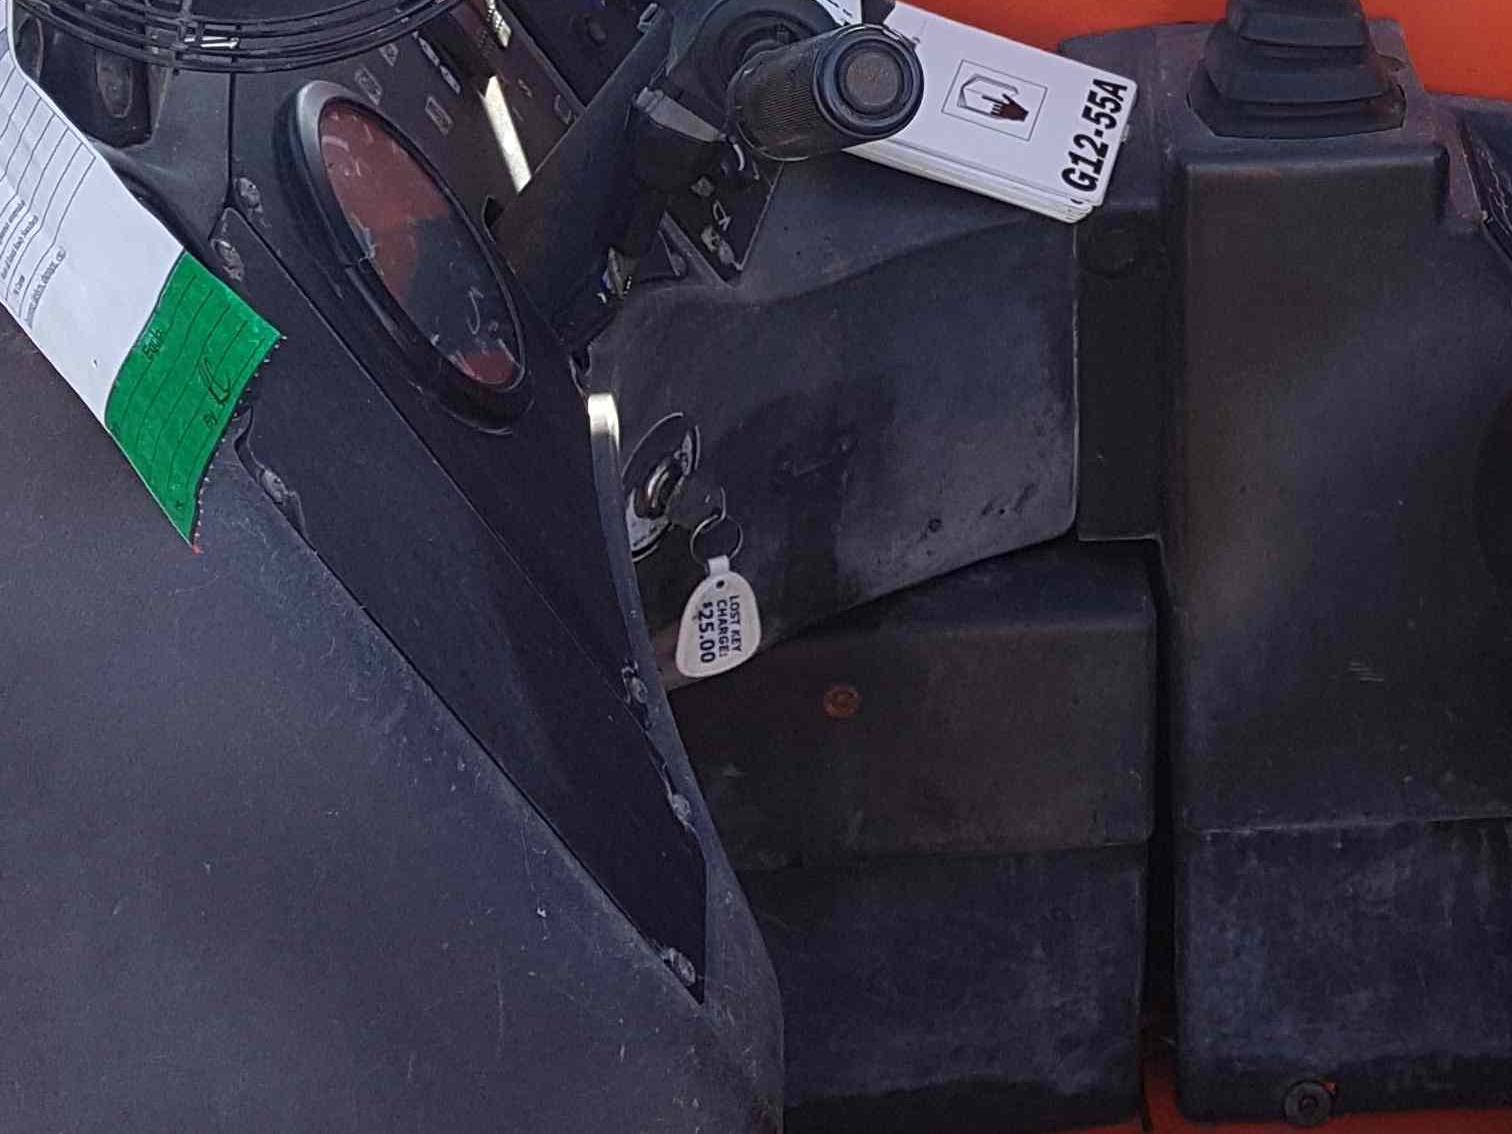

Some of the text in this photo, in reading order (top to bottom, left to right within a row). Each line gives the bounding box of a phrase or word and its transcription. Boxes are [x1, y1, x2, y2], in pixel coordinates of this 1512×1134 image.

[1061, 78, 1128, 192] G12-55A
[697, 602, 716, 663] $25.00
[729, 595, 742, 652] LOST KEY
